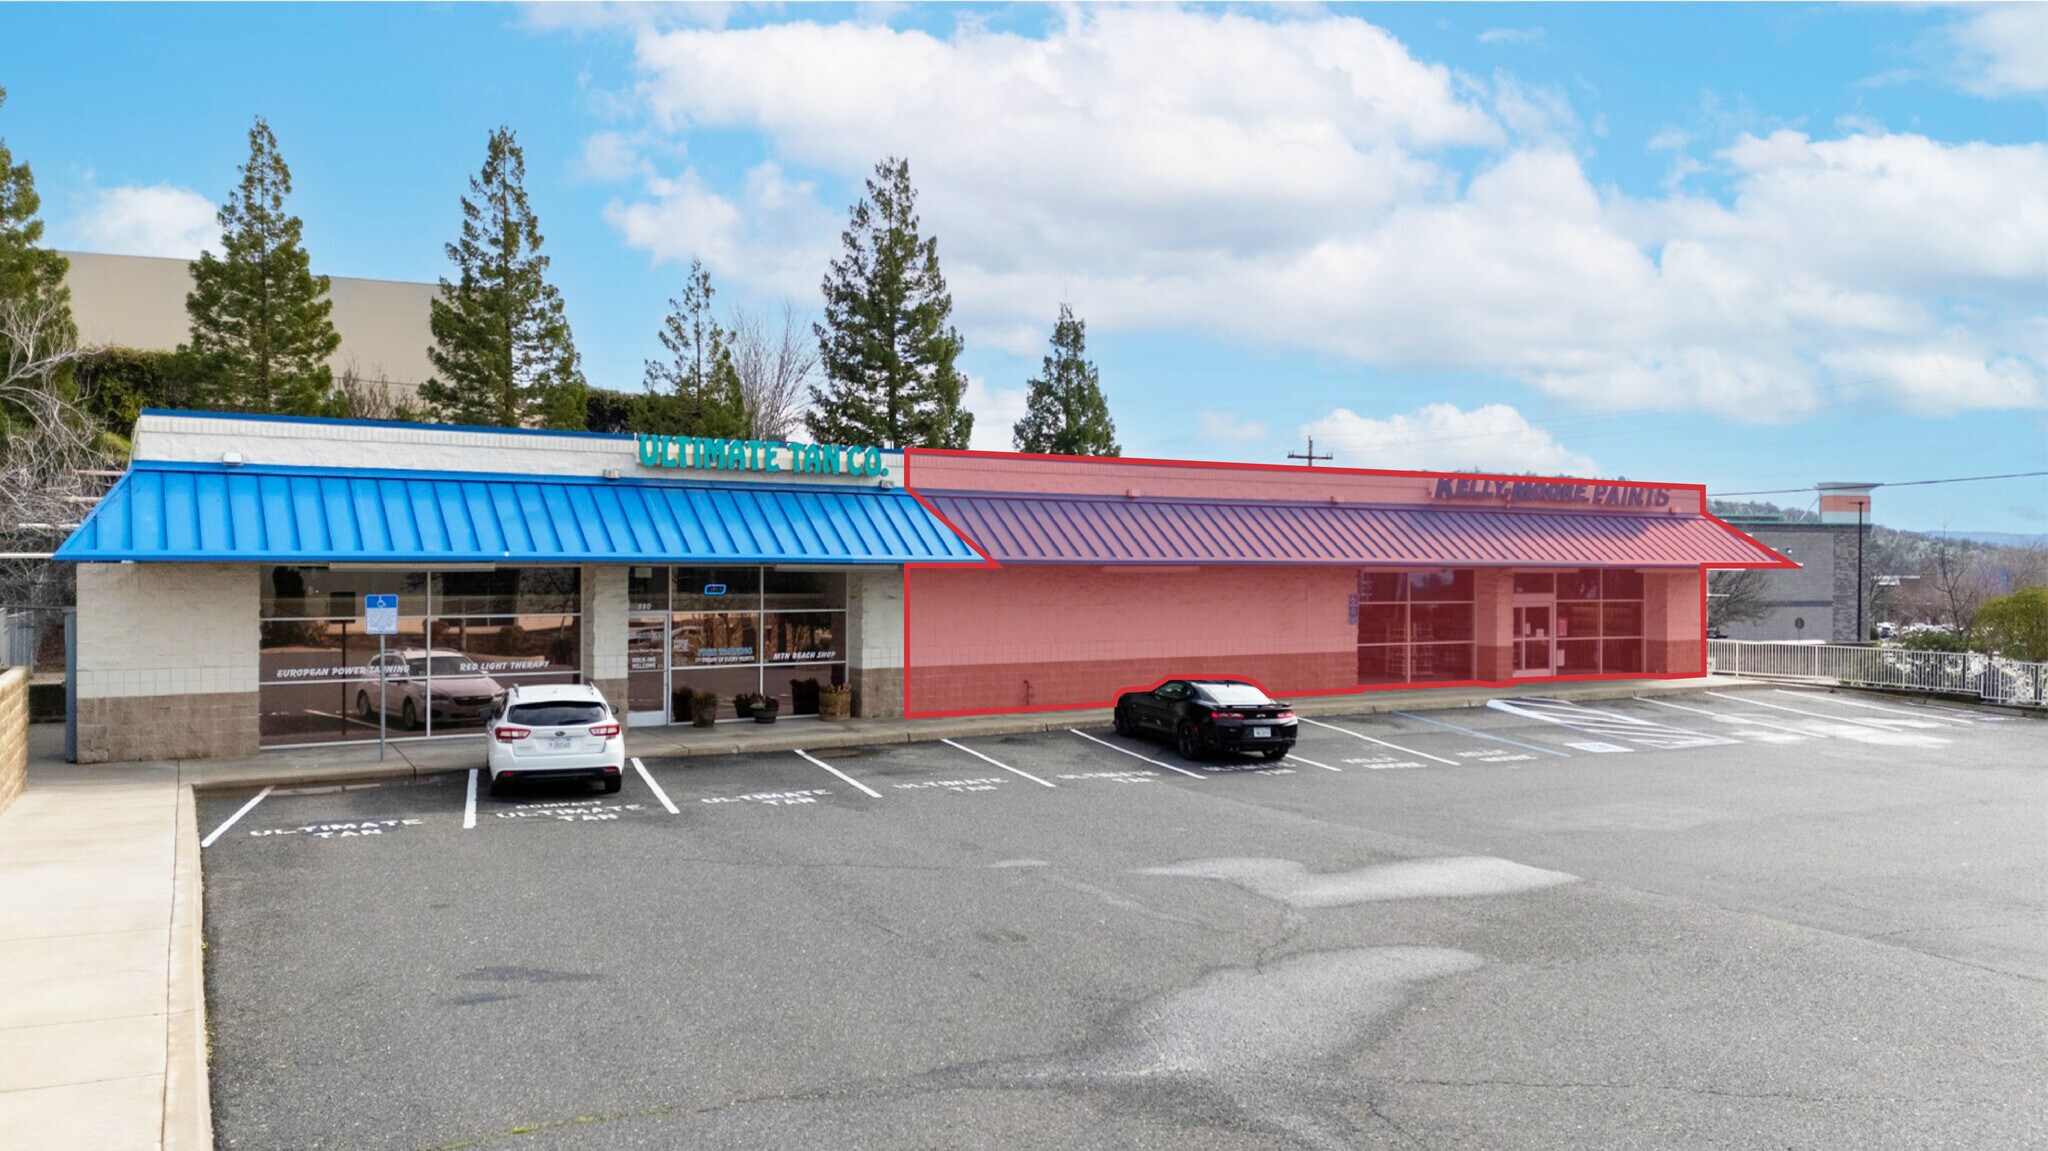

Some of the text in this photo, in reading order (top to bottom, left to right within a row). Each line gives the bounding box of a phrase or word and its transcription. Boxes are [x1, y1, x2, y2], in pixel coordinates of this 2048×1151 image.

[639, 433, 889, 477] ULTIMATE TAN CO.
[1592, 484, 1671, 507] PAINTS
[773, 650, 837, 660] MTN BEACH SHOP
[276, 664, 410, 678] EUROPEAN POWER TANING
[460, 660, 550, 672] RED LIGHT THERAPY
[701, 789, 833, 804] ULTIMATE
[761, 797, 818, 806] TAN
[496, 804, 646, 819] ULTIMATE
[557, 814, 618, 822] TAN
[250, 818, 424, 837] ULTIMATE
[313, 829, 383, 838] TAN
